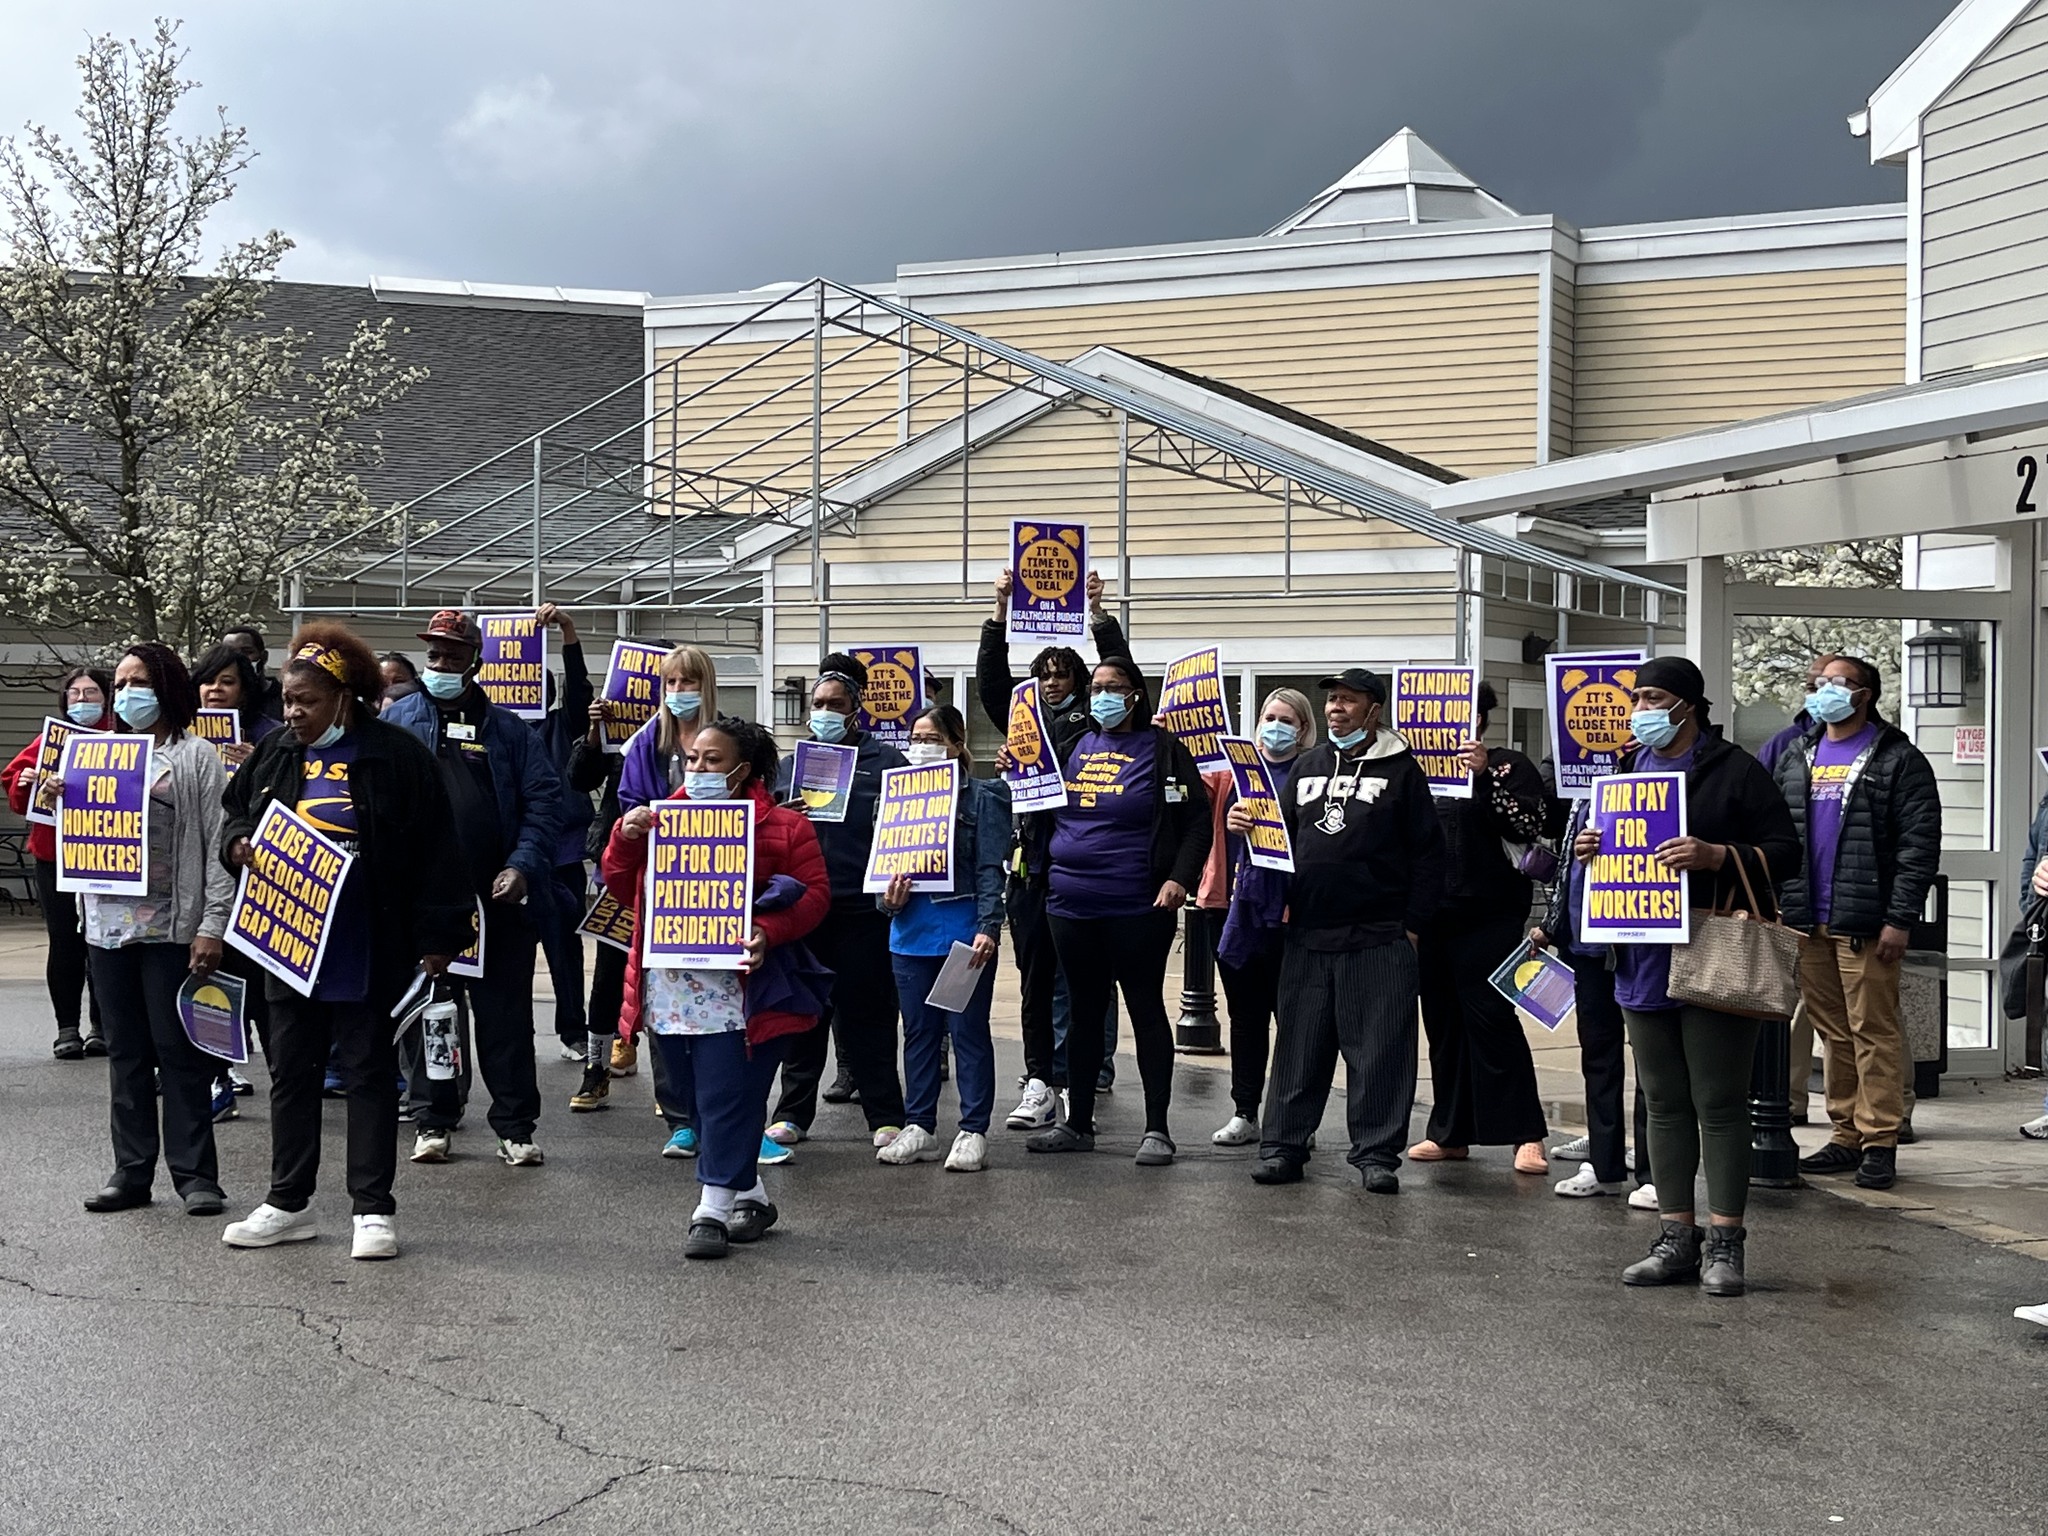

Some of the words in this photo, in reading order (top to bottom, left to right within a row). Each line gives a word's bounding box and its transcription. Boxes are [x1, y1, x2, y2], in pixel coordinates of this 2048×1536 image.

[2015, 454, 2048, 514] 2
[1036, 546, 1058, 556] IT'S
[1021, 569, 1052, 579] CLOSE
[1054, 570, 1074, 580] THE
[1027, 557, 1054, 568] TIME
[1055, 559, 1069, 569] TO
[1036, 580, 1062, 591] DEAL
[1012, 610, 1055, 622] HEALTHCARE
[1056, 612, 1084, 622] BUDGET
[1040, 600, 1050, 609] ON
[1050, 601, 1055, 610] A
[486, 619, 513, 637] FAIR
[514, 618, 537, 637] PAY
[1011, 620, 1024, 631] FOR
[1024, 621, 1035, 631] ALL
[1036, 622, 1052, 632] NEW
[499, 640, 522, 659] FOR
[480, 663, 542, 682] HOMECARE
[618, 648, 644, 673] FAIR
[644, 652, 665, 676] PA
[1167, 651, 1216, 685] STANDING
[873, 669, 895, 680] IT'S
[892, 679, 906, 689] TO
[1400, 672, 1470, 696] STANDING
[626, 676, 652, 700] FOR
[892, 690, 912, 700] THE
[1161, 687, 1174, 709] UP
[1173, 681, 1195, 706] FOR
[1196, 677, 1219, 702] OUR
[1586, 692, 1613, 703] IT'S
[875, 702, 900, 712] DEAL
[1165, 705, 1214, 733] ATIENTS
[1213, 704, 1223, 726] &
[1398, 700, 1415, 723] UP
[1417, 700, 1442, 723] FOR
[1444, 700, 1471, 723] OUR
[1573, 705, 1606, 717] TIME
[1609, 705, 1625, 717] TO
[891, 721, 896, 730] A
[1024, 720, 1032, 731] TO
[1568, 719, 1606, 730] CLOSE
[1608, 719, 1631, 730] THE
[1026, 731, 1039, 742] THE
[1586, 732, 1617, 743] DEAL
[1957, 741, 1966, 752] IN
[1968, 740, 1985, 753] USE
[43, 746, 58, 767] UP
[72, 742, 108, 769] FAIR
[109, 743, 141, 771] PAY
[1017, 746, 1036, 757] DEAL
[1592, 754, 1605, 764] ON
[1605, 754, 1611, 764] A
[1082, 761, 1121, 775] Saving
[1561, 764, 1613, 775] HEALTHCARE
[86, 775, 118, 804] FOR
[888, 767, 951, 798] STANDING
[1245, 769, 1266, 793] FOR
[1296, 775, 1389, 806] UCF
[1562, 775, 1578, 786] FOR
[1578, 775, 1592, 785] ALL
[1601, 782, 1632, 813] FAIR
[1635, 781, 1669, 812] PAY
[883, 802, 900, 824] UP
[901, 798, 925, 821] FOR
[926, 794, 951, 819] OUR
[63, 808, 142, 839] HOMECARE
[659, 808, 745, 838] STANDING
[1615, 818, 1648, 848] FOR
[878, 822, 936, 849] PATIENTS
[937, 821, 948, 844] &
[62, 841, 142, 873] WORKERS!
[263, 813, 313, 865] CLOSE
[309, 844, 343, 886] THE
[655, 844, 677, 873] UP
[679, 844, 711, 873] FOR
[713, 844, 746, 873] OUR
[873, 849, 946, 875] RESIDENTS!
[254, 844, 330, 914] MEDICAID
[654, 879, 730, 909] PATIENTS
[732, 880, 744, 909] &
[1589, 889, 1681, 920] WORKERS!
[246, 873, 323, 944] COVERAGE
[238, 903, 271, 940] GAP
[268, 923, 315, 973] NOW!
[653, 915, 743, 945] RESIDENTS!
